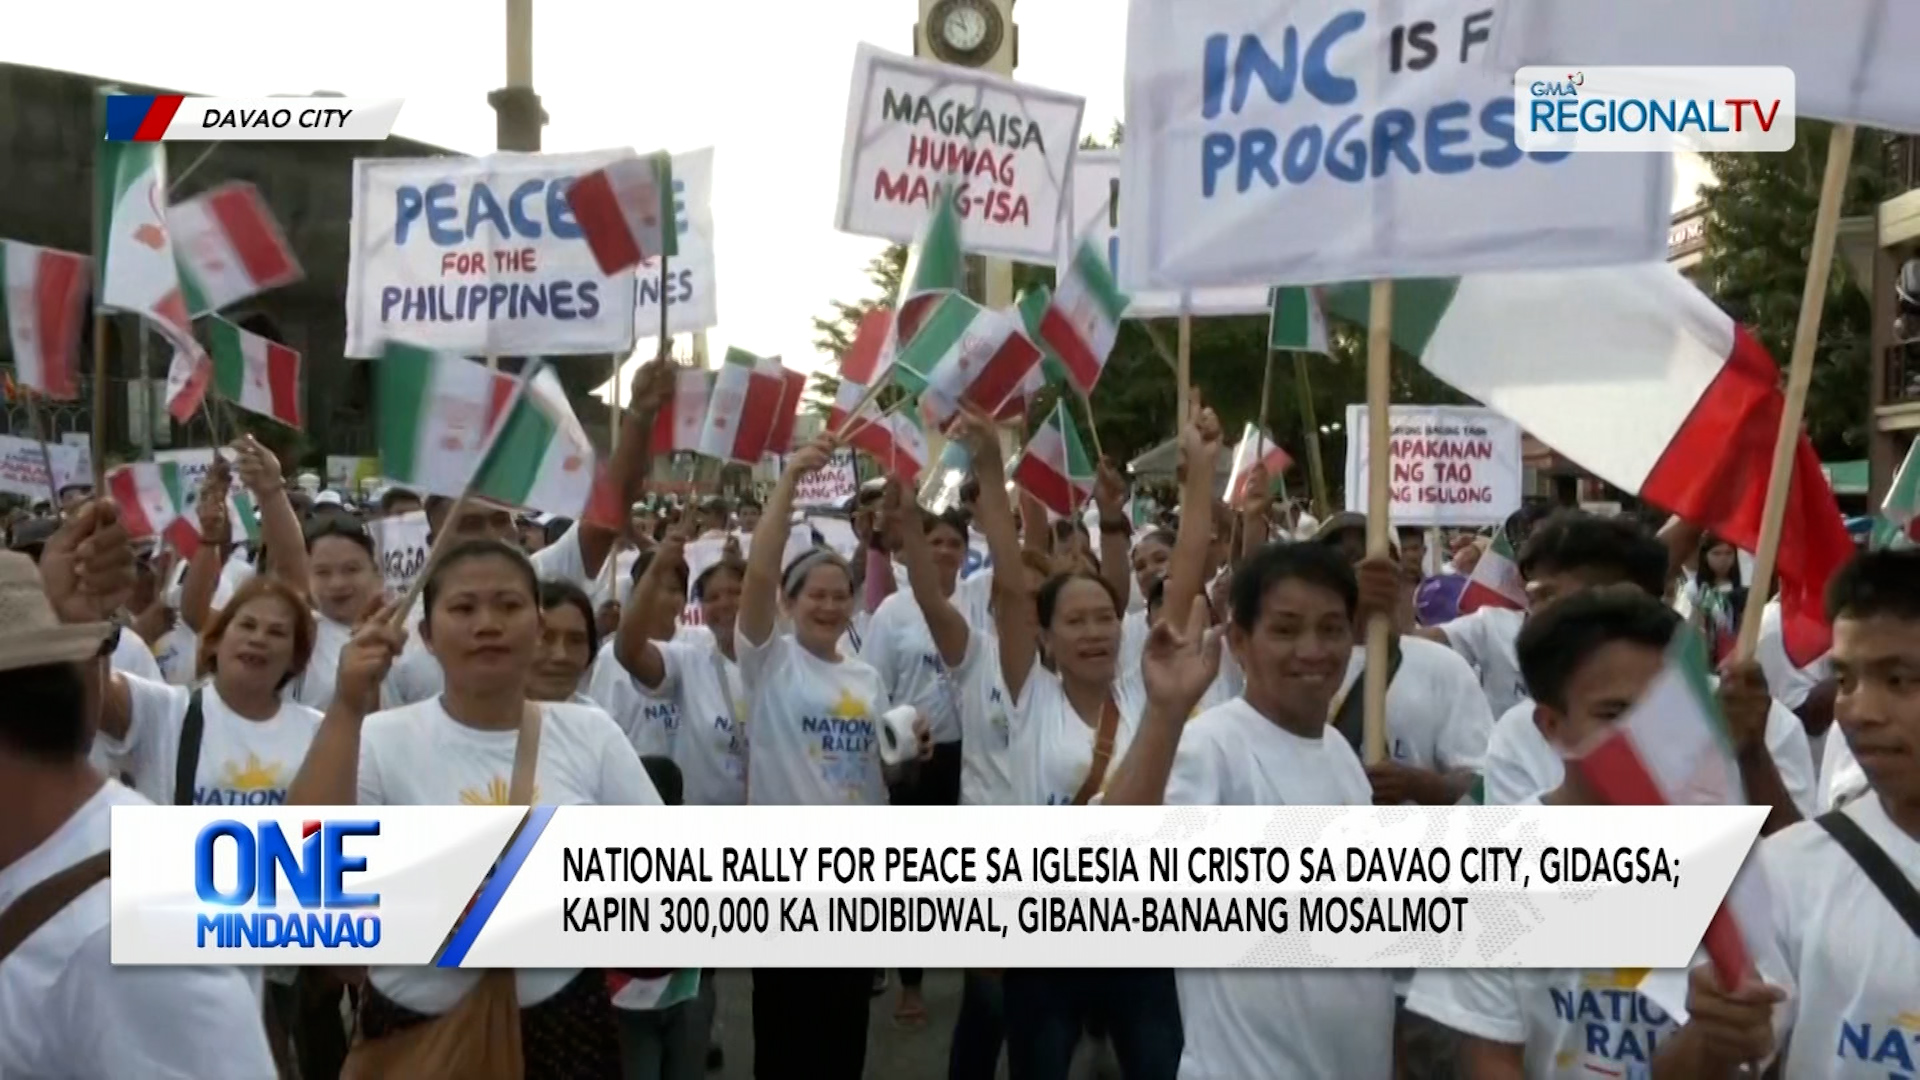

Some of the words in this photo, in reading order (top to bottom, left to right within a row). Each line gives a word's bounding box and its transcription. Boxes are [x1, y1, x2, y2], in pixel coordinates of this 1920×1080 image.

[1203, 11, 1366, 119] INC
[1390, 21, 1439, 73] IS
[882, 86, 1045, 154] MAGKAISA
[907, 134, 1016, 187] HUWAG
[1202, 97, 1573, 197] PROGRES
[441, 253, 486, 276] FOR
[493, 247, 537, 273] THE
[381, 280, 600, 322] PHILIPPINES
[1388, 440, 1492, 459] APAKANAN
[1394, 463, 1424, 482] NG
[1434, 462, 1472, 483] TAO
[1418, 486, 1492, 503] ISULONG
